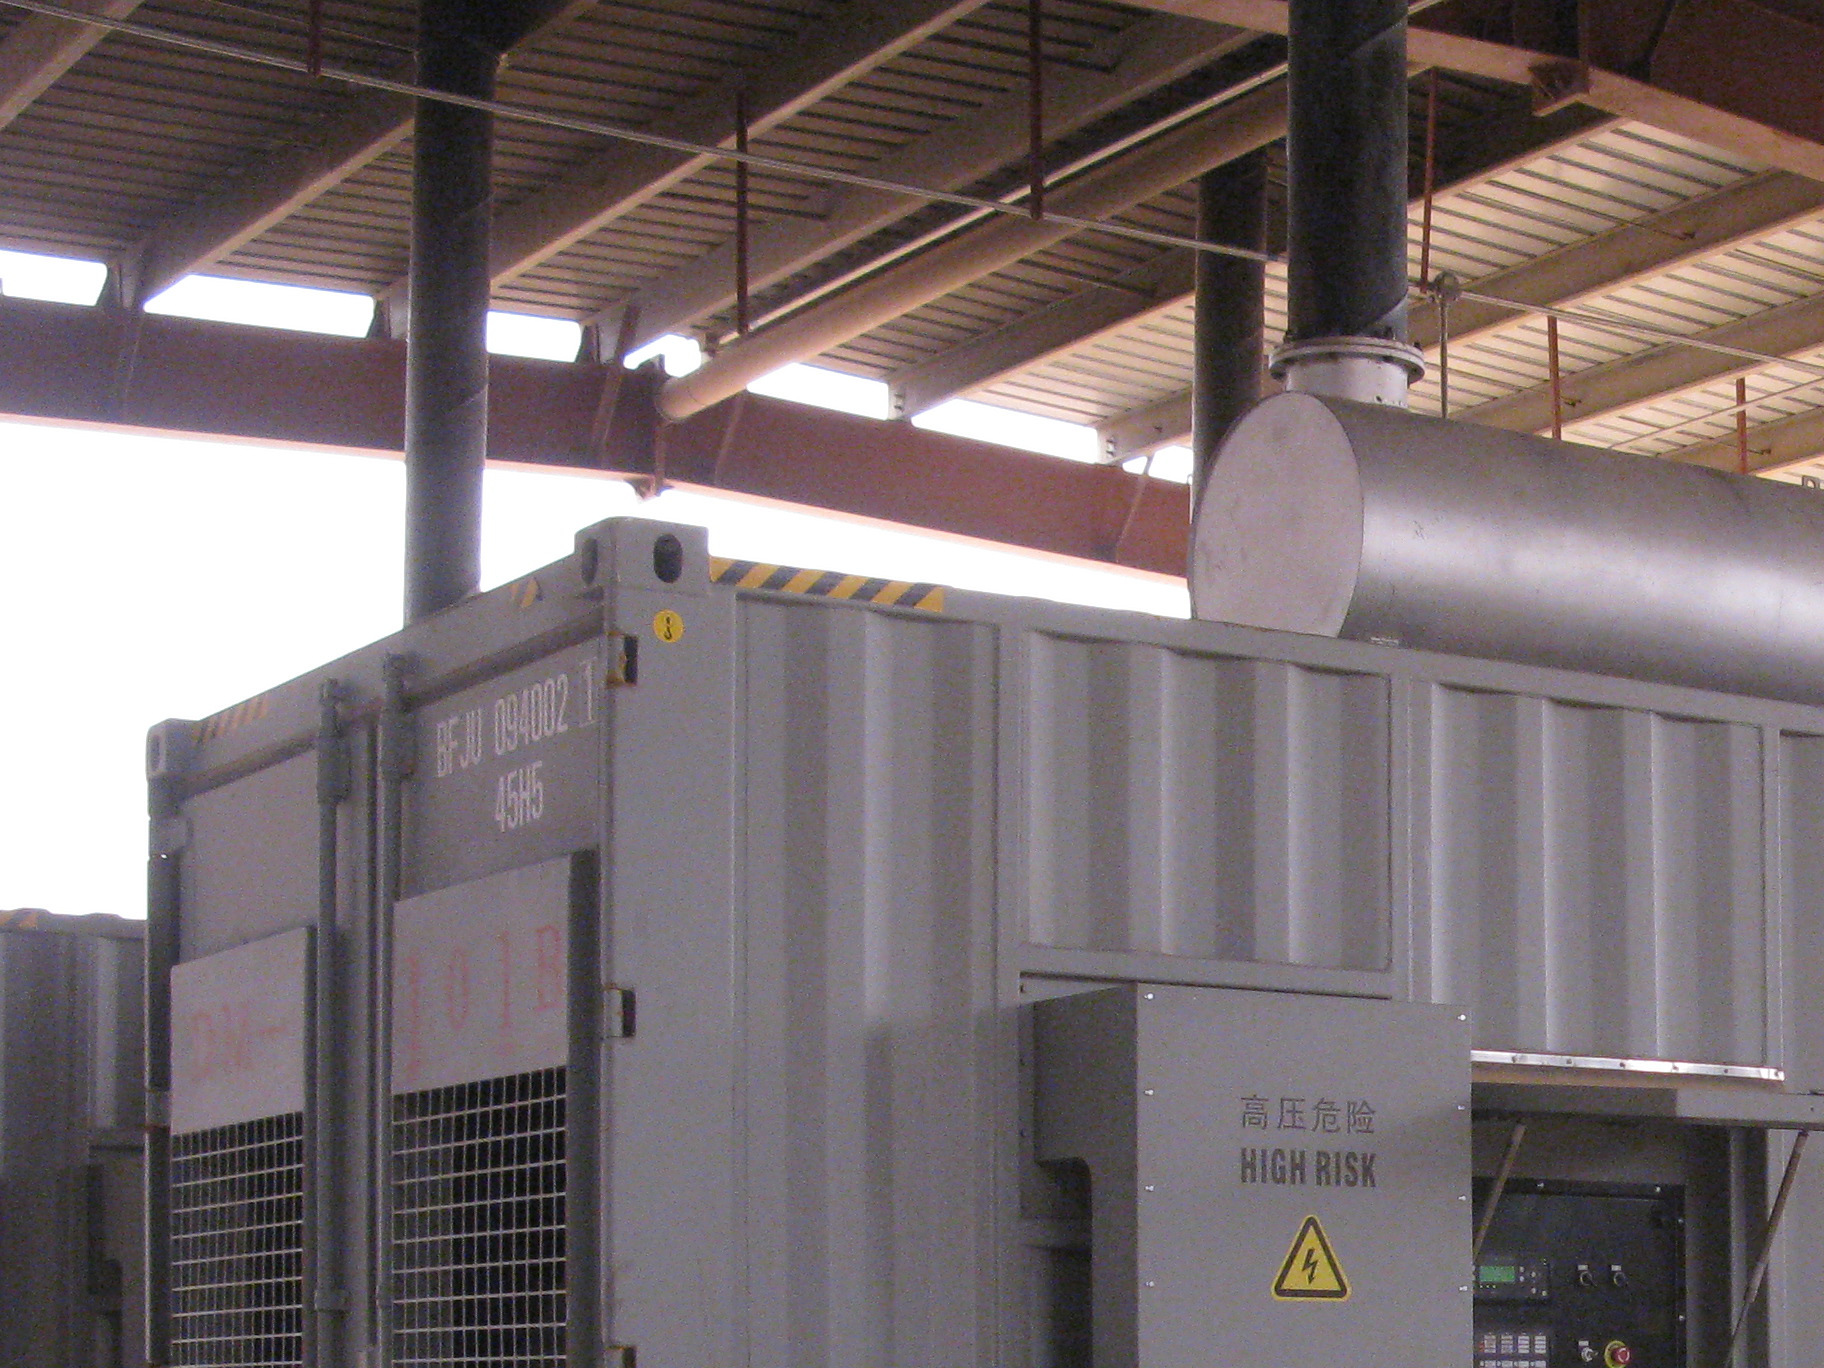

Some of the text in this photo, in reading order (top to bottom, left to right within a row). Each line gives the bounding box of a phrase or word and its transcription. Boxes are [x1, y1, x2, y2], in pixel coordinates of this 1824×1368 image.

[436, 708, 481, 777] BFJU
[494, 673, 568, 756] 094002
[494, 760, 543, 832] 45H5
[1241, 1094, 1376, 1134] 高压危险
[1240, 1148, 1376, 1187] HIGH RISK
